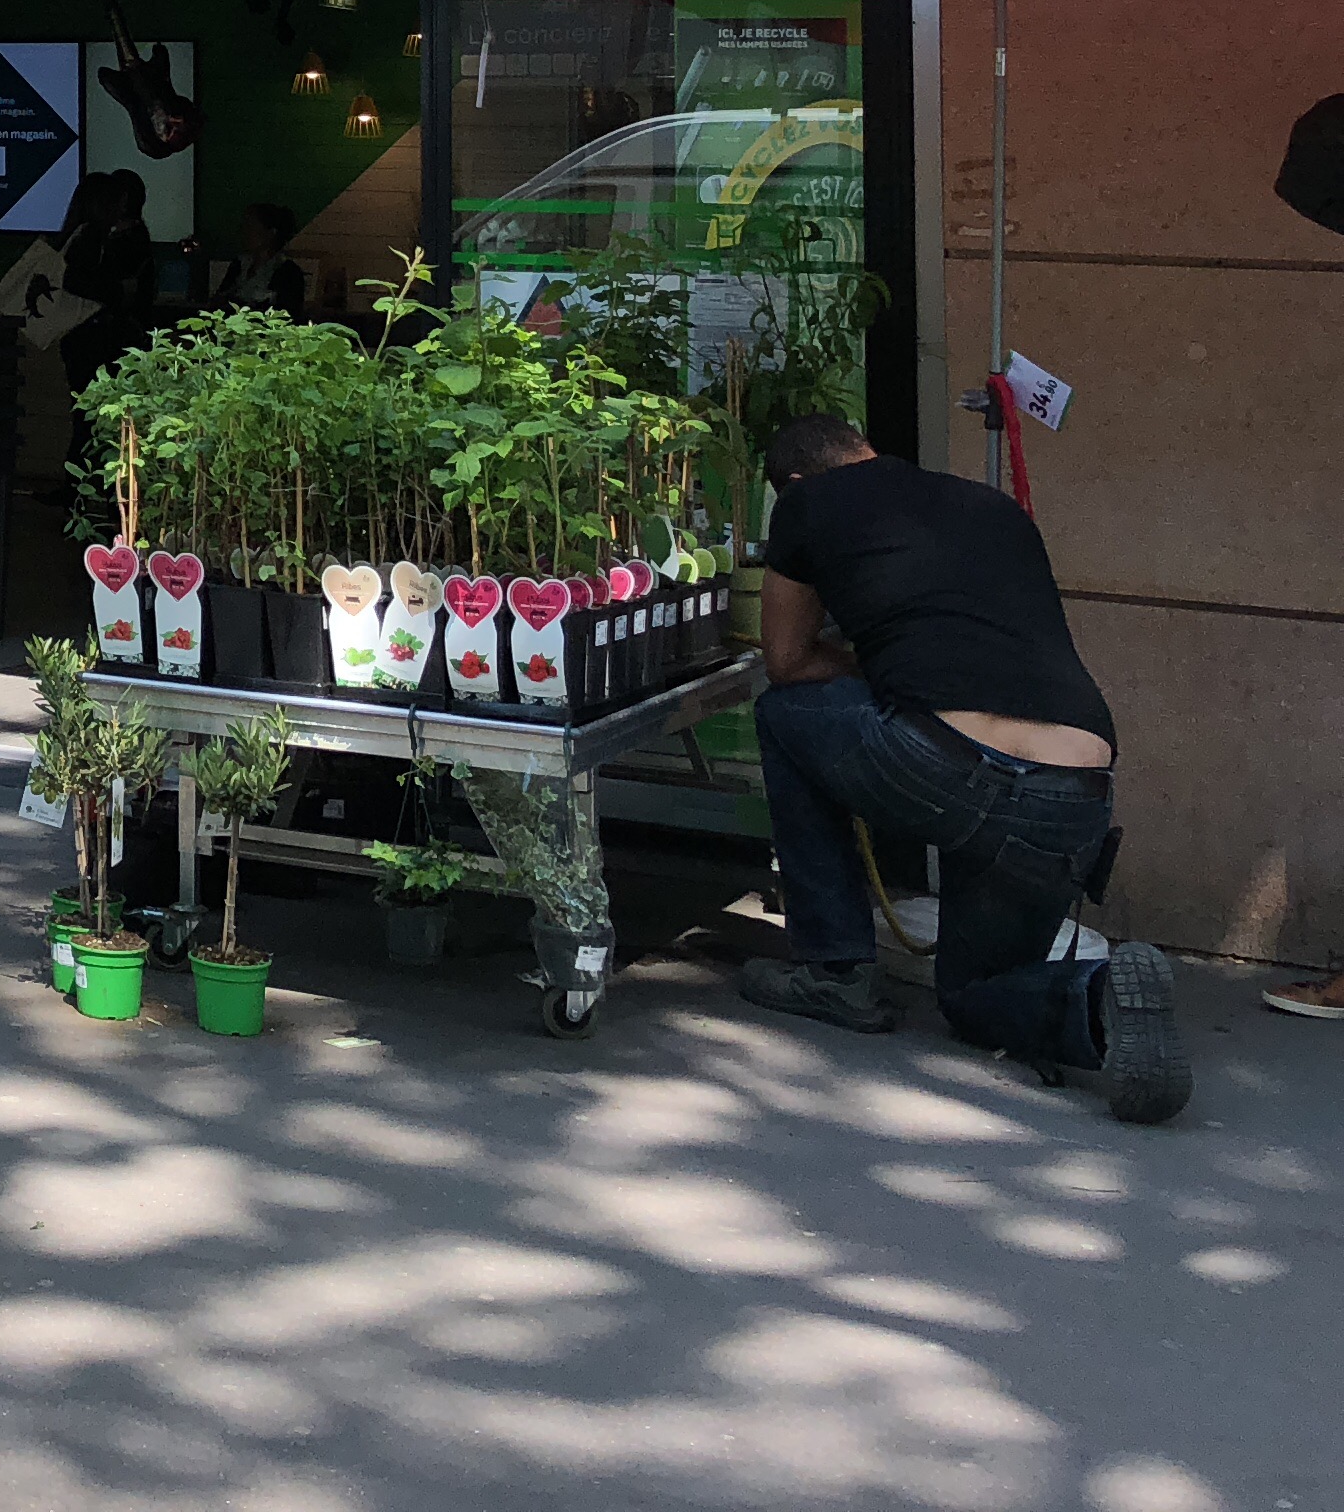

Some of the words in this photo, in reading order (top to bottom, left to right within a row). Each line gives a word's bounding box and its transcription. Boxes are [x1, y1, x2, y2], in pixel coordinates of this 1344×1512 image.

[718, 28, 737, 40] ICI,
[738, 28, 753, 38] JE
[755, 28, 808, 38] RECYCLE
[736, 40, 770, 48] LAMPES
[10, 129, 58, 142] magasin.
